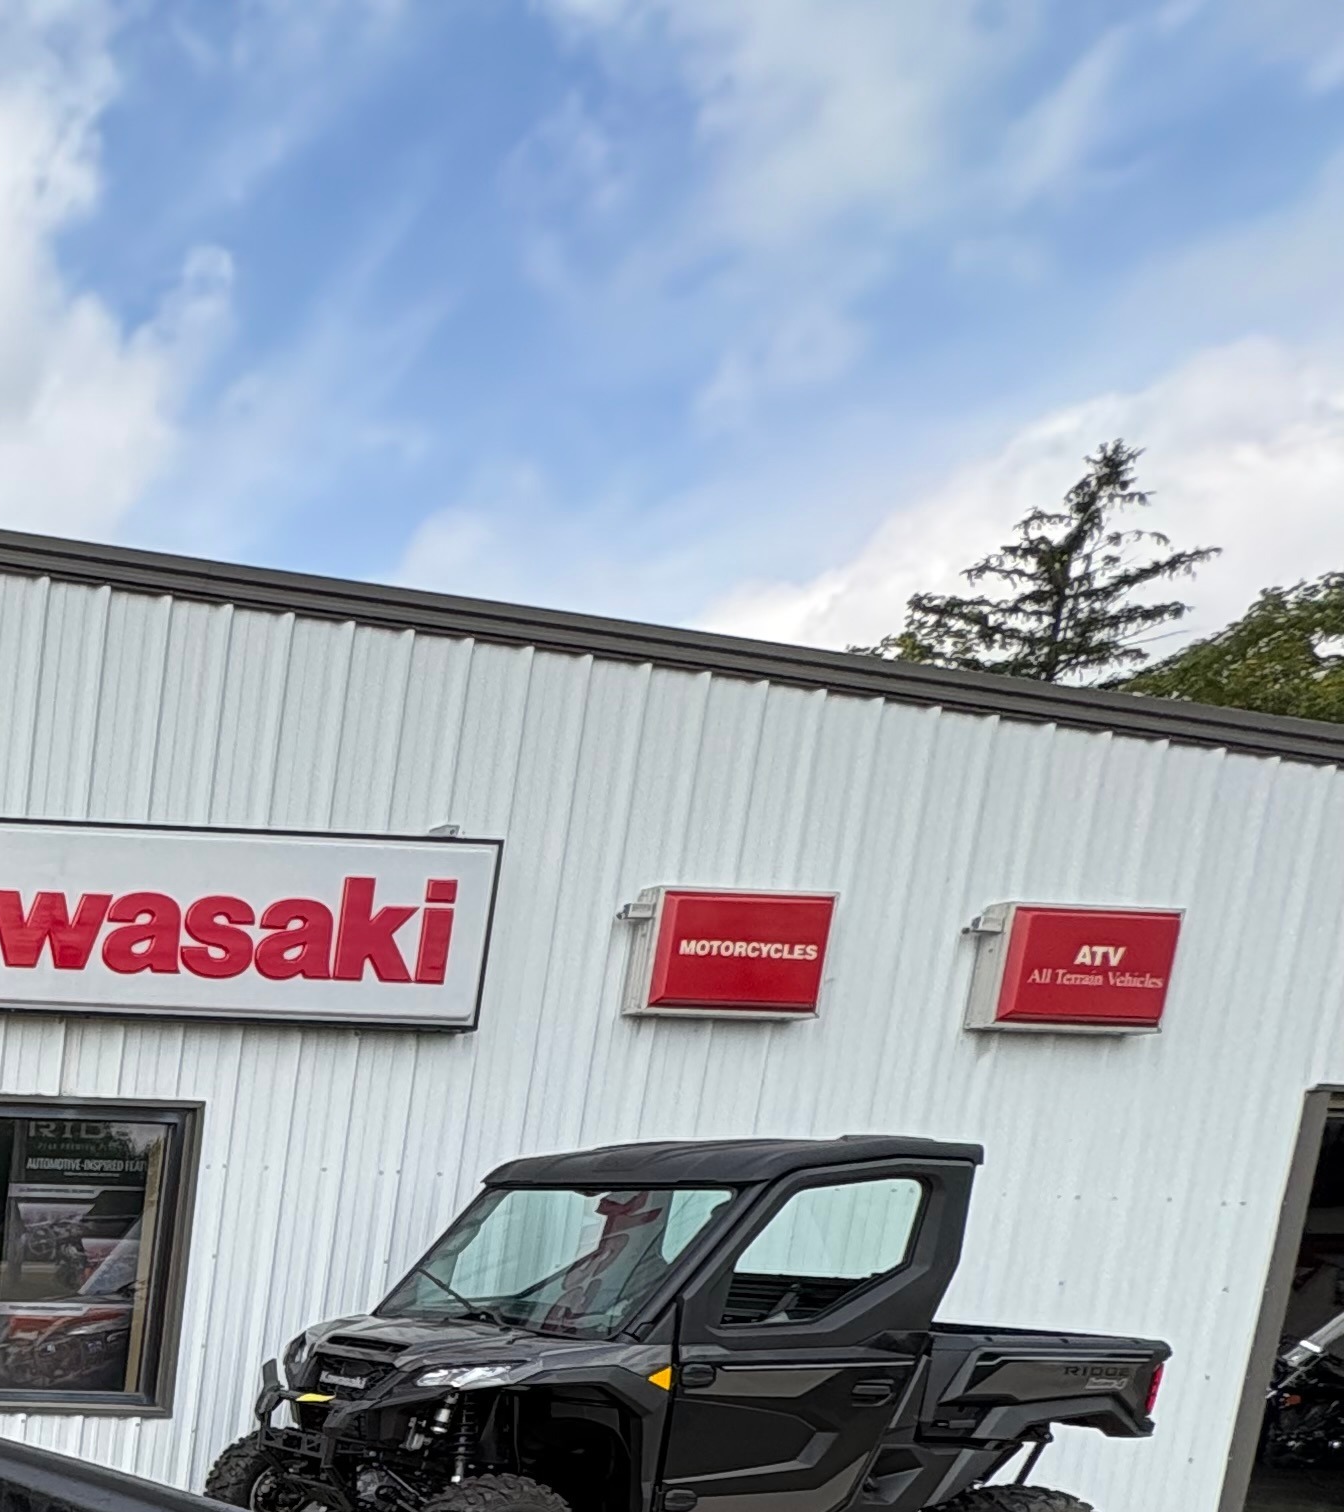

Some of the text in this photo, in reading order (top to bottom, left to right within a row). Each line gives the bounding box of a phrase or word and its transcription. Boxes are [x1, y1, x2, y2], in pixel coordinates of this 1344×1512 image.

[679, 939, 819, 961] MOTORCYCLES
[1073, 945, 1127, 967] ATV
[1027, 968, 1164, 990] All Terrain Vehicles
[1064, 1366, 1130, 1377] RIDGE
